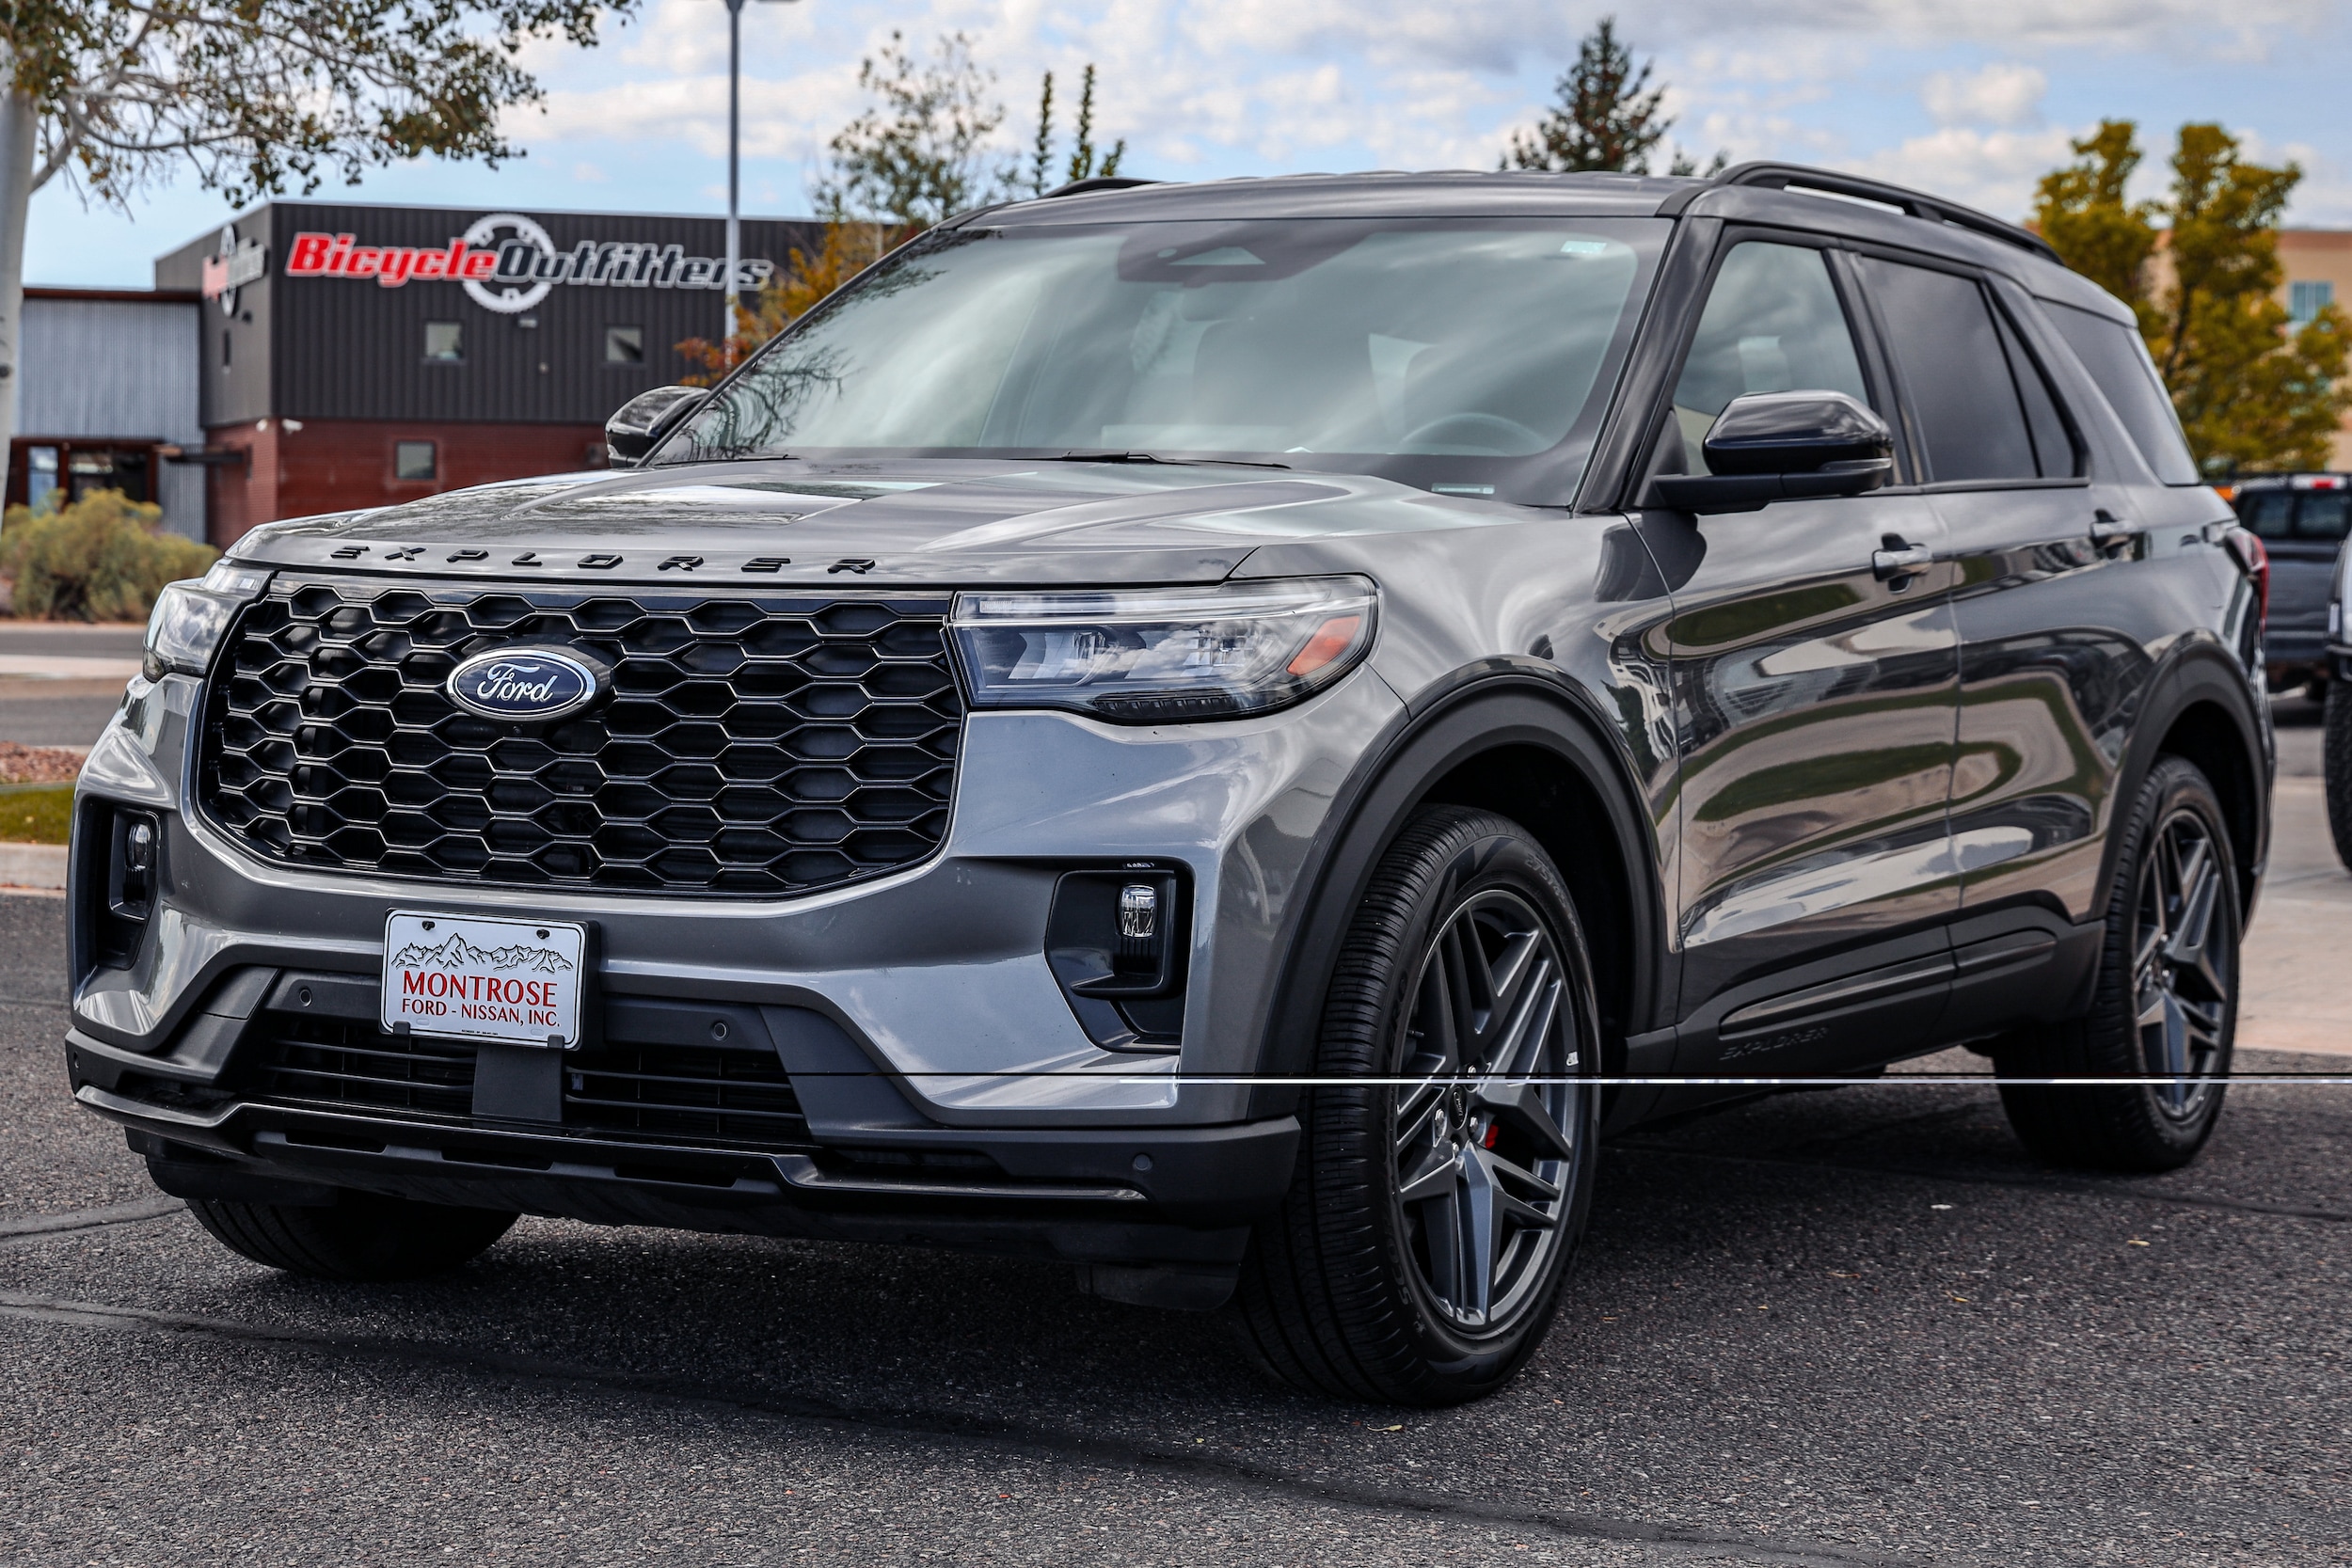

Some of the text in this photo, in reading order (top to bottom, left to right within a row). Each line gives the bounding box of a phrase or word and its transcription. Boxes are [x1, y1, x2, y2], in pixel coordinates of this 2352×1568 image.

[286, 232, 500, 287] Bicycle
[494, 239, 774, 291] Outfitters
[329, 545, 877, 575] EXPLORER
[477, 663, 559, 702] Ford
[403, 971, 558, 1007] MONTROSE
[402, 998, 448, 1016] FORD
[461, 1004, 524, 1026] NISSAN,
[528, 1009, 561, 1027] INC.
[1718, 1026, 1828, 1061] EXPLORER
